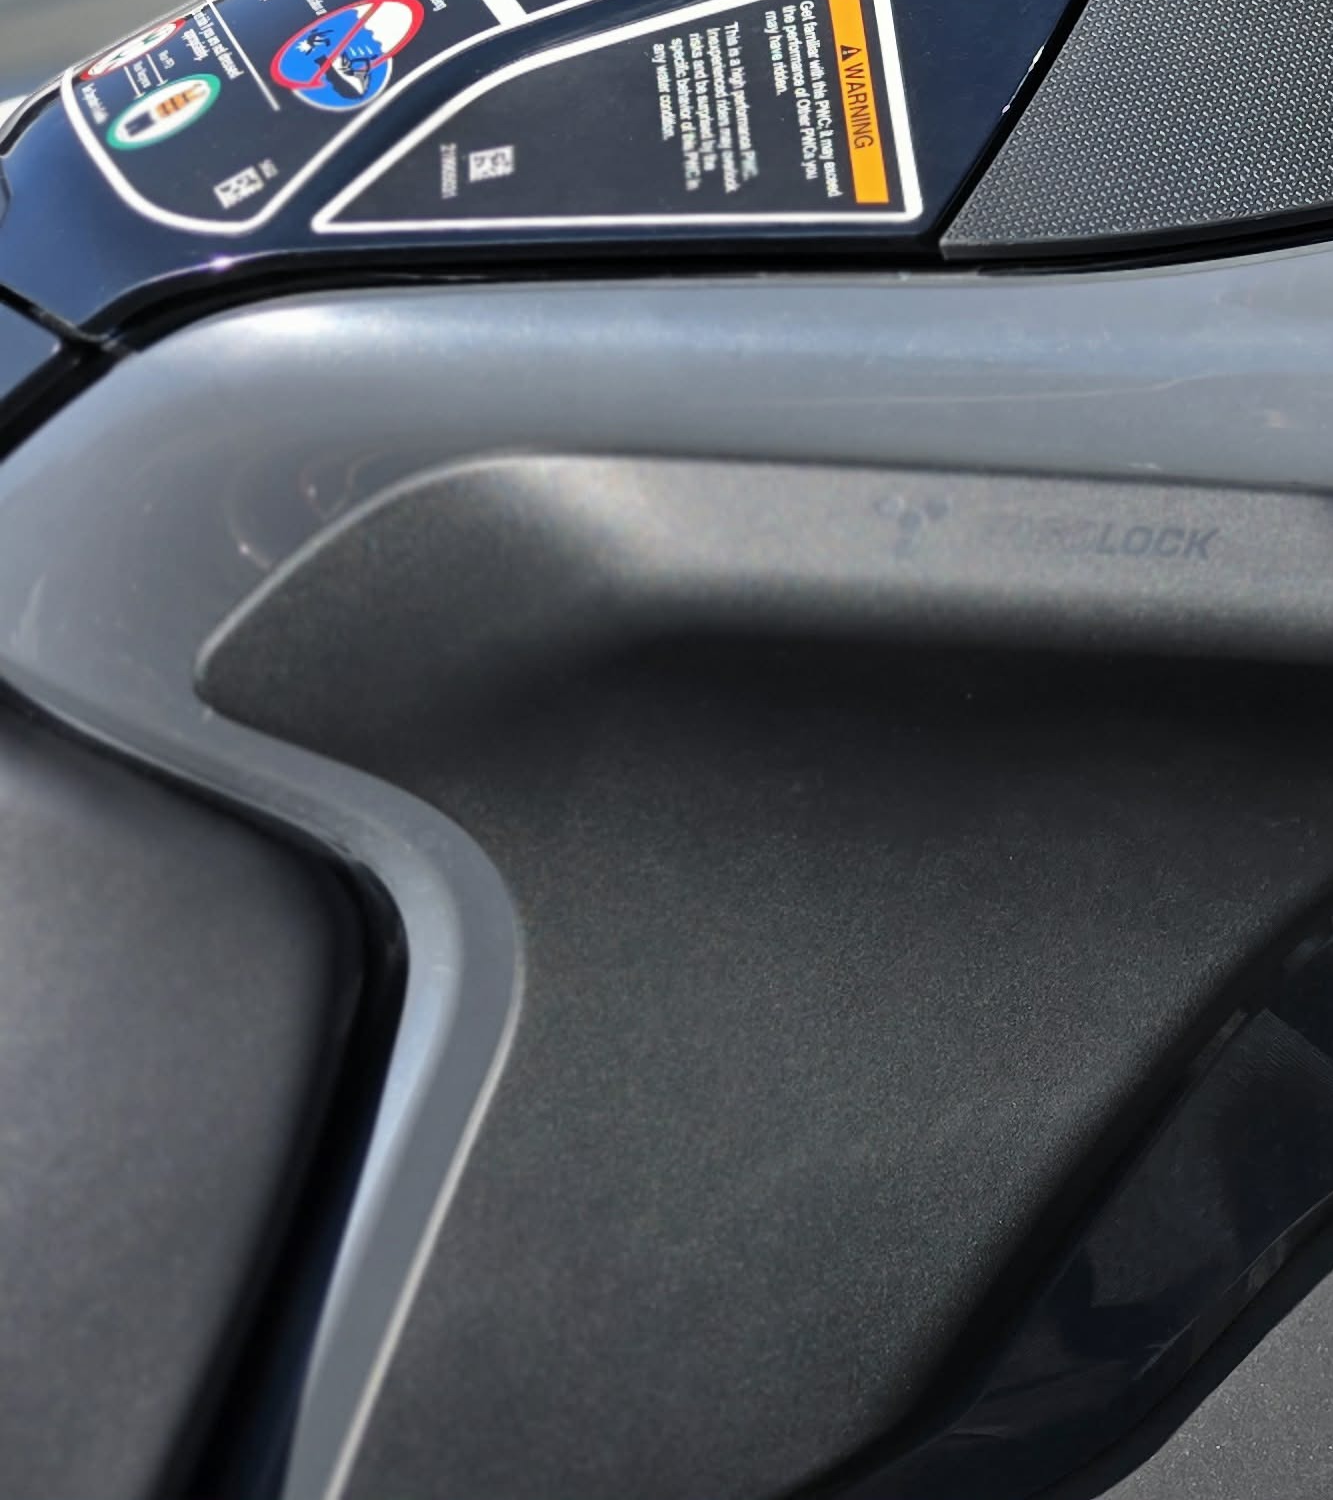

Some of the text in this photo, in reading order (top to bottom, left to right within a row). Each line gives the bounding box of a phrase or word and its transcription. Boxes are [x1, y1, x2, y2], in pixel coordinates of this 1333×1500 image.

[783, 5, 798, 23] the
[799, 0, 817, 21] Get
[689, 33, 706, 58] risks
[724, 22, 740, 46] This
[804, 22, 821, 58] familiar
[651, 43, 668, 64] any
[669, 38, 689, 78] specific
[706, 28, 728, 97] Inexperienced
[728, 48, 744, 57] is
[764, 11, 789, 95] may have ridden.
[784, 25, 806, 86] performance
[658, 65, 674, 93] water
[693, 60, 708, 79] and
[730, 67, 748, 89] high
[810, 60, 825, 80] with
[696, 80, 710, 95] be
[794, 88, 809, 98] of
[812, 81, 828, 99] this
[675, 80, 693, 121] behavior
[844, 62, 874, 149] WARNING
[715, 99, 730, 127] riders
[732, 90, 752, 149] performance
[800, 128, 817, 159] PWCs
[819, 130, 834, 138] it
[816, 139, 833, 160] may
[801, 161, 819, 179] you
[825, 162, 842, 197] exceed
